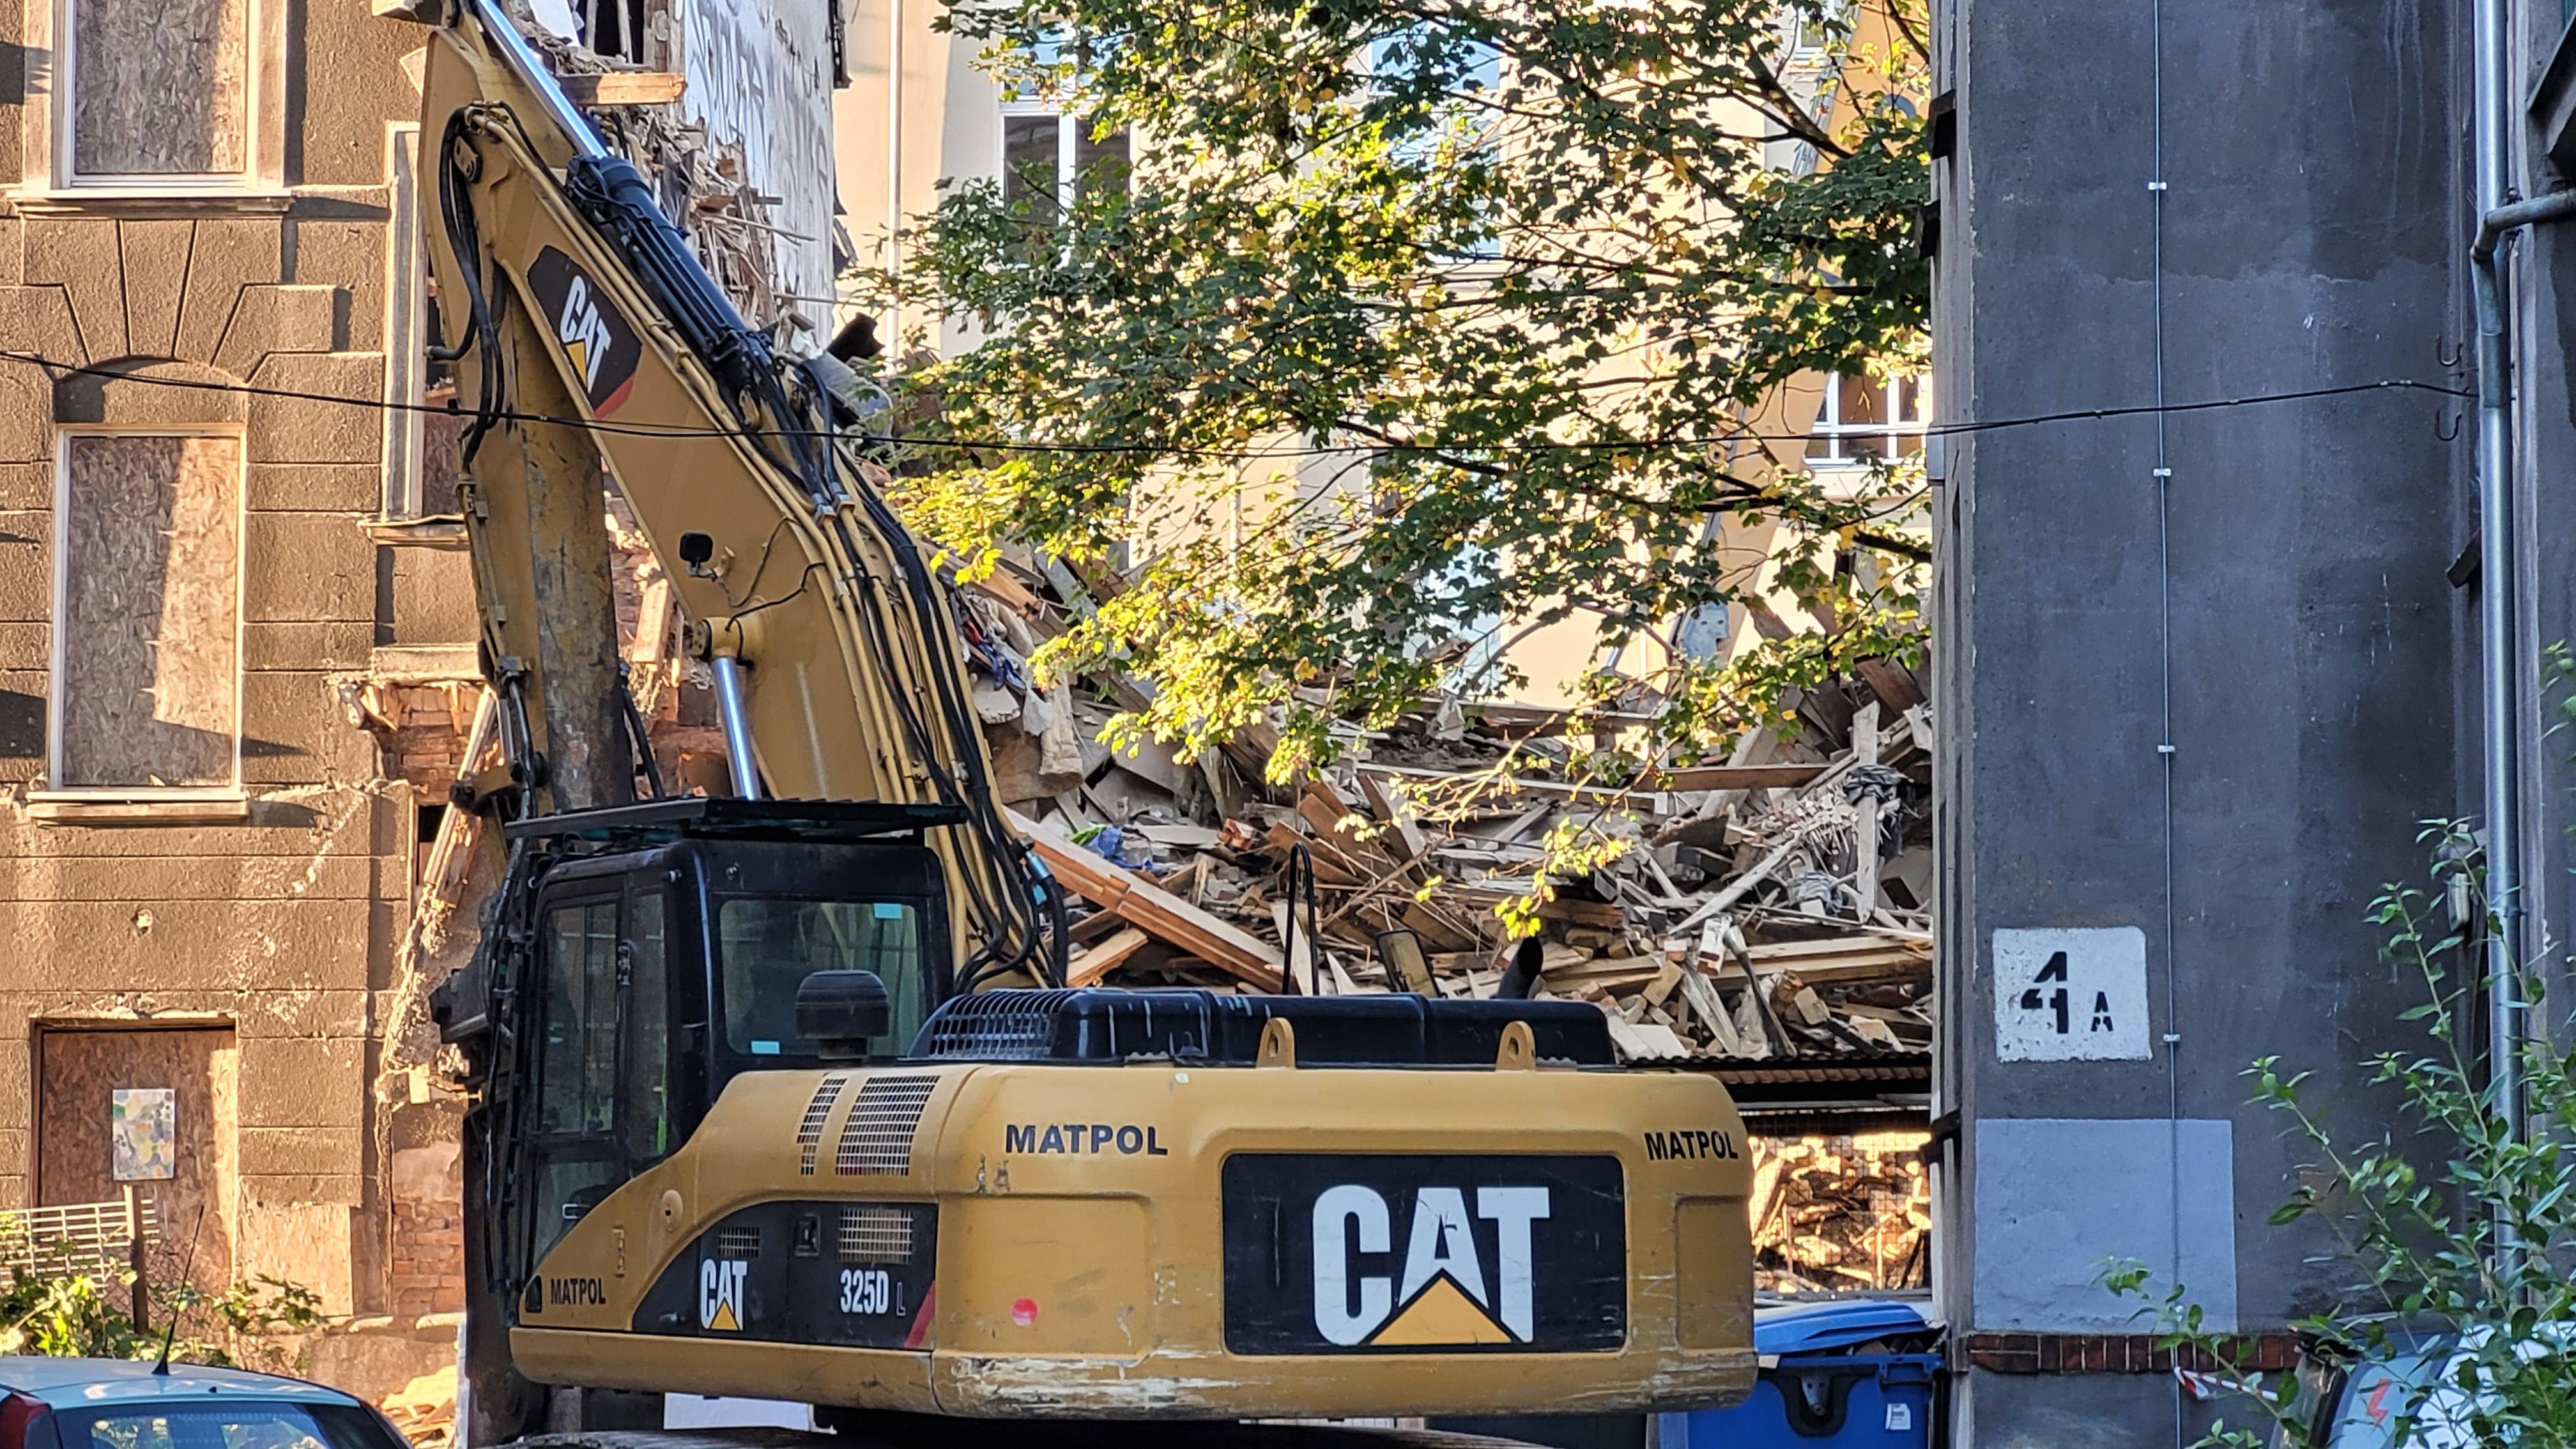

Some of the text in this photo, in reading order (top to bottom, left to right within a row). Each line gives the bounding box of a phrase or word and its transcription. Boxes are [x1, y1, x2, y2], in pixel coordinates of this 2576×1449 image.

[560, 275, 612, 394] CAT
[1005, 1124, 1169, 1156] MATPOL
[1644, 1130, 1738, 1161] MATPOL
[1312, 1184, 1551, 1346] CAT
[550, 1278, 606, 1305] MATPOL
[701, 1259, 747, 1331] CAT
[839, 1269, 889, 1314] 325D
